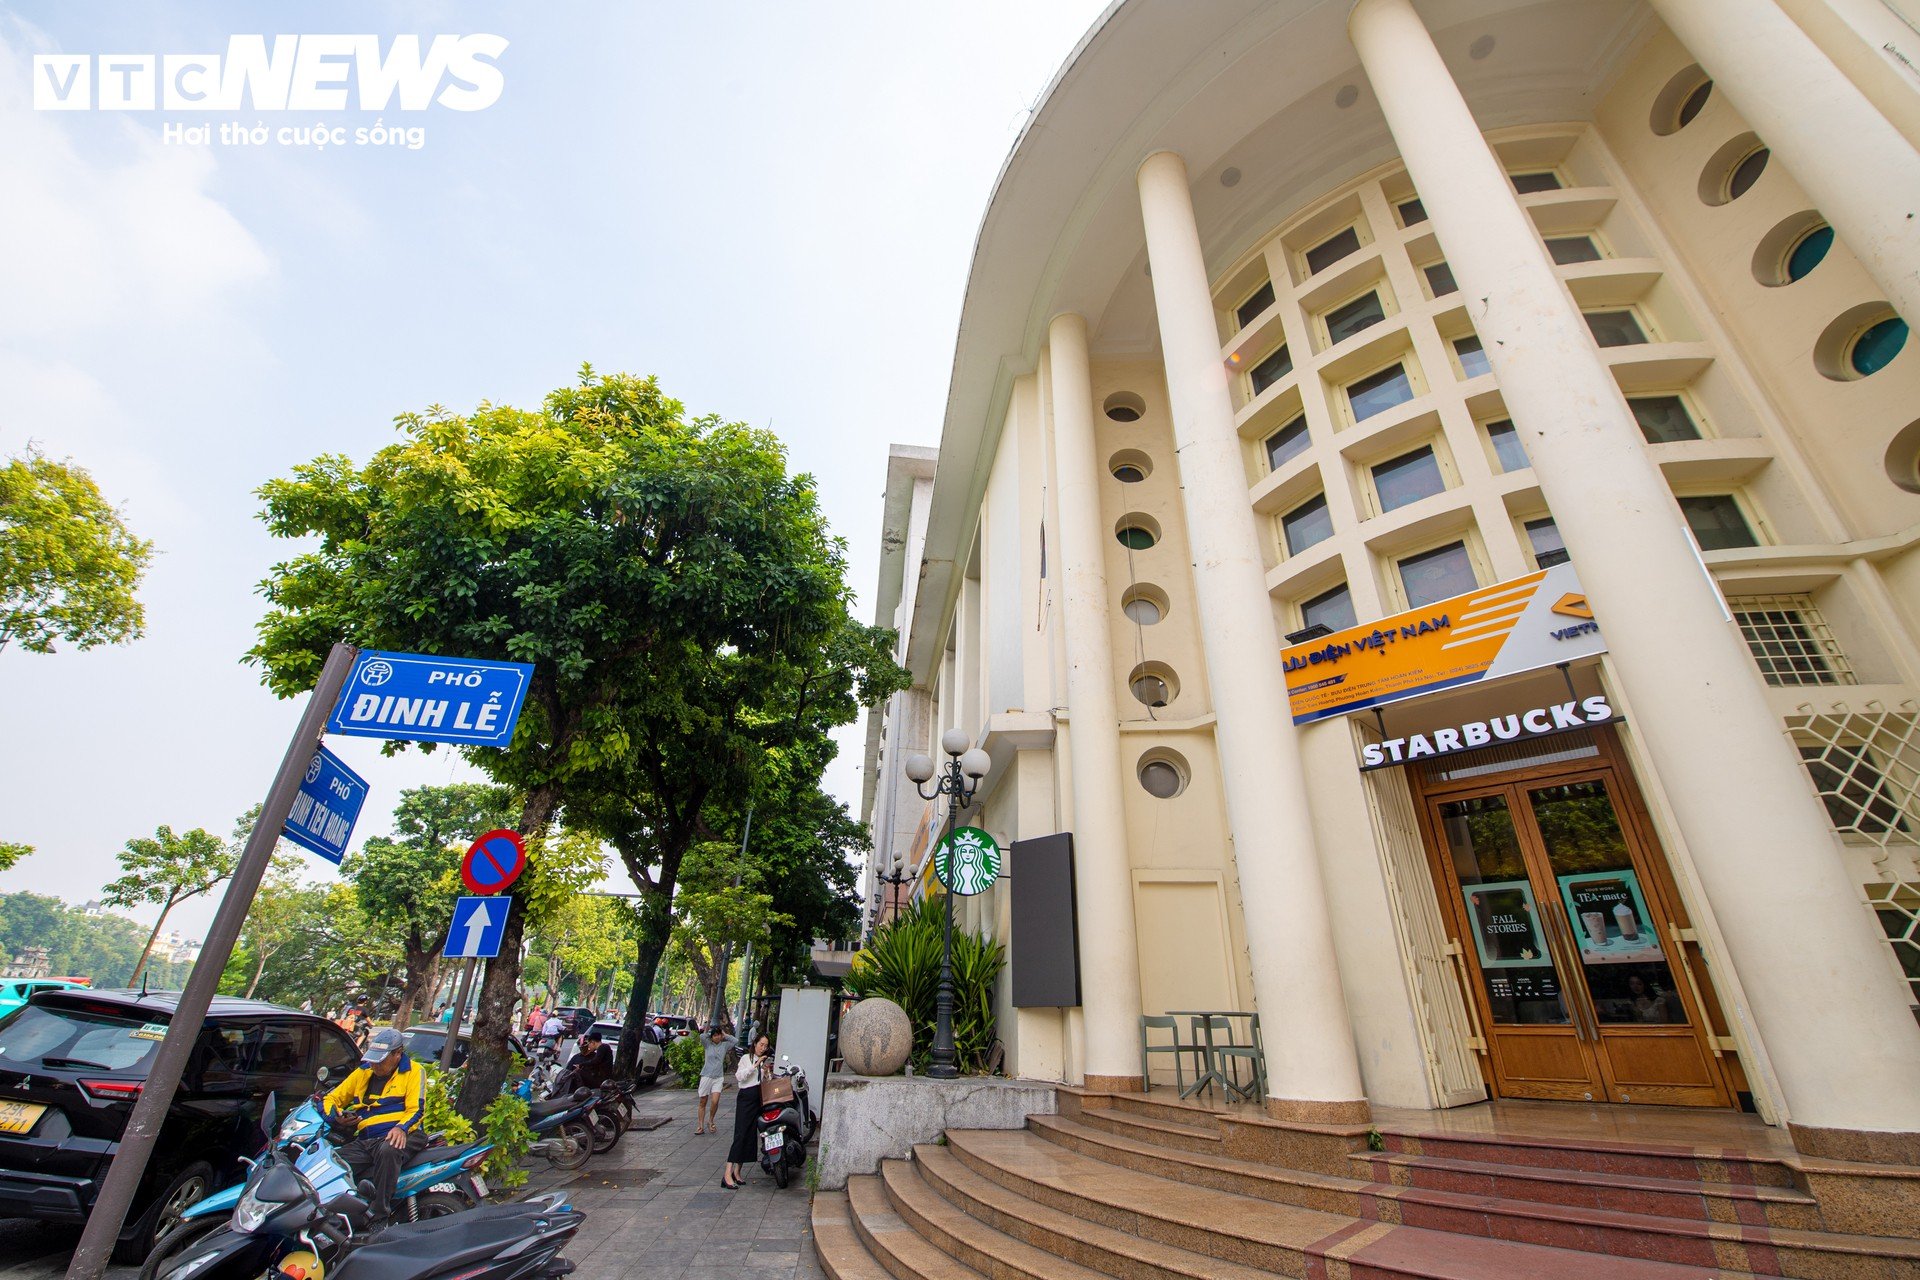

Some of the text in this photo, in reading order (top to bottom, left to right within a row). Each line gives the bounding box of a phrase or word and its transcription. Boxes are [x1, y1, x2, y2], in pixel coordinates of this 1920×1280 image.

[1352, 629, 1397, 655] VIỆT
[1401, 614, 1450, 639] NAM
[428, 669, 488, 687] PHỐ
[349, 690, 502, 731] ĐINH LỄ
[1362, 696, 1612, 766] STARBUCKS
[329, 776, 354, 800] PHỐ
[1486, 923, 1527, 934] STORIES
[1492, 914, 1516, 924] FALL
